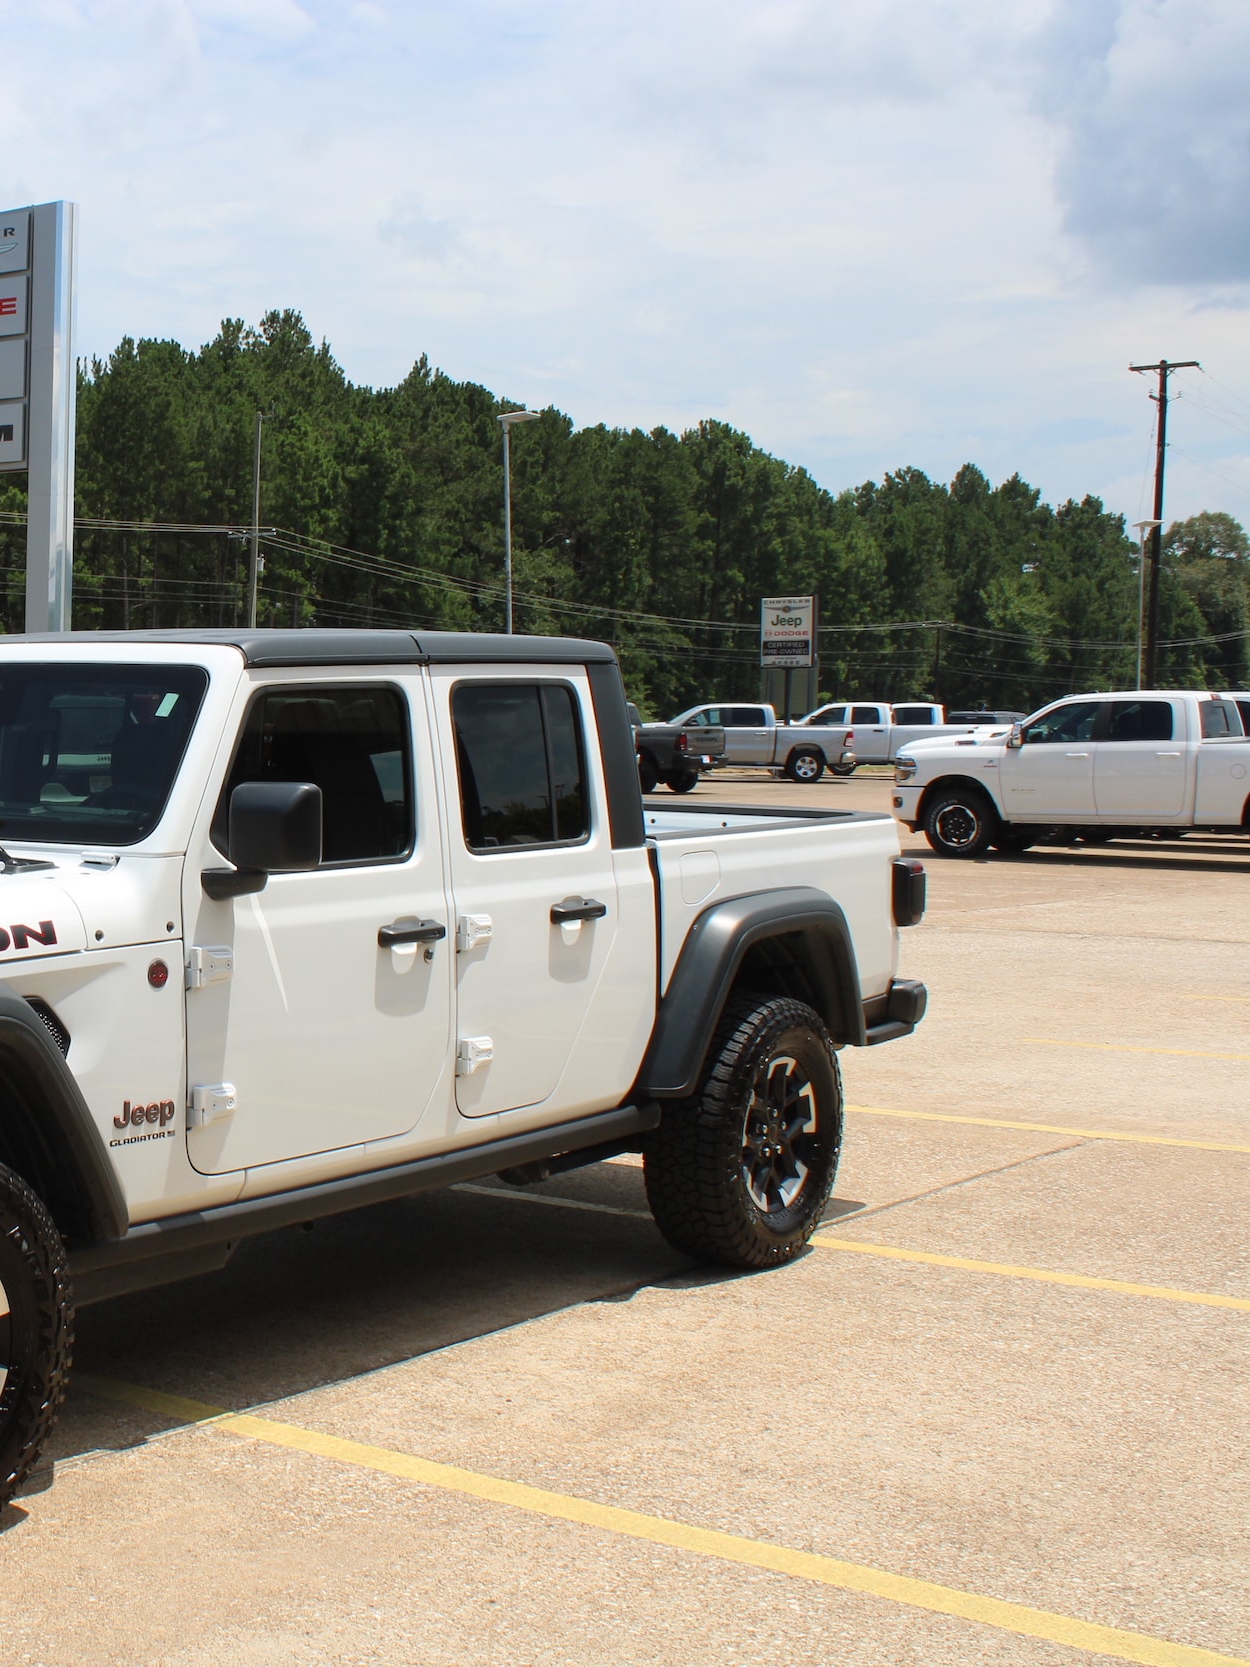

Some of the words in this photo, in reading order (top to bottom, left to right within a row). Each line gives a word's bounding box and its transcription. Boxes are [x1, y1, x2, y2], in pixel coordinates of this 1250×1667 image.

[771, 614, 802, 628] Jeep
[113, 1099, 175, 1129] Jeep
[110, 1131, 165, 1147] GLADIATOR
